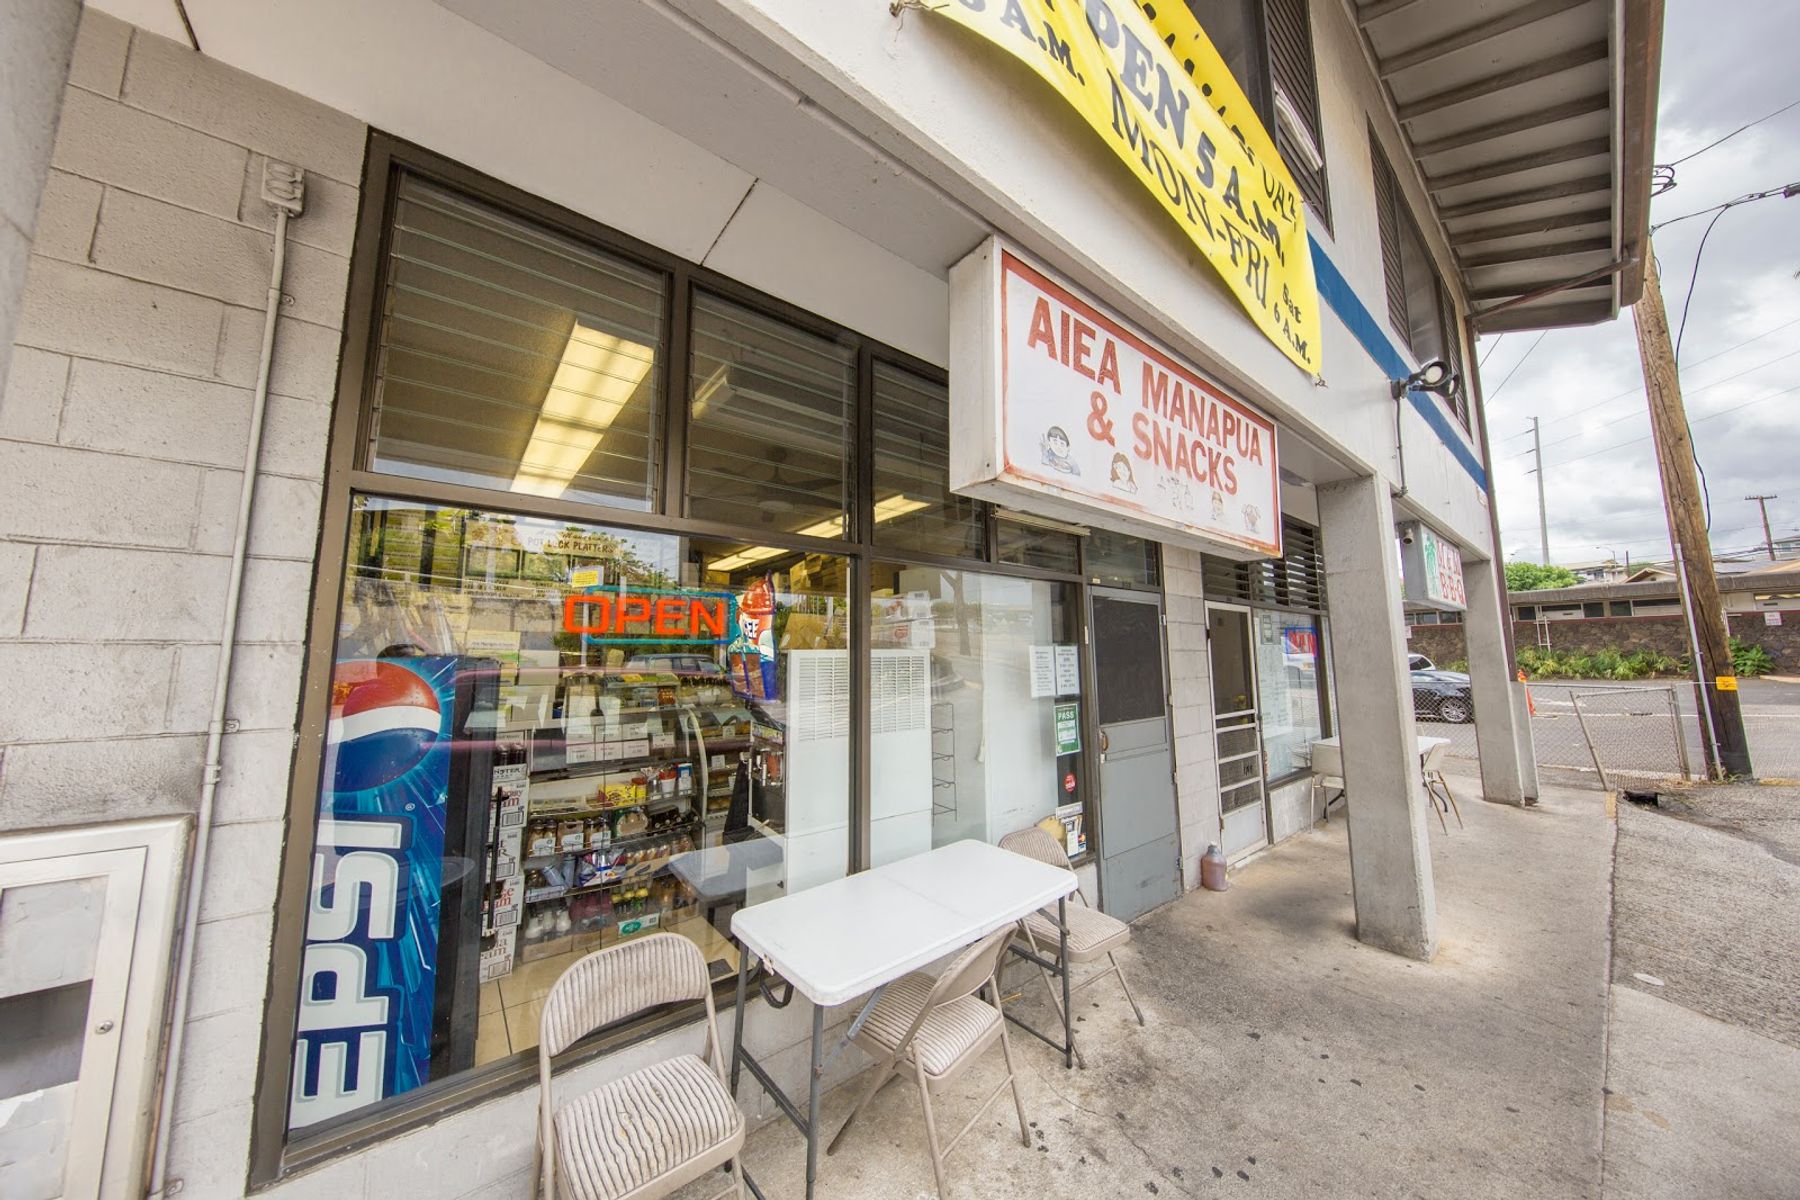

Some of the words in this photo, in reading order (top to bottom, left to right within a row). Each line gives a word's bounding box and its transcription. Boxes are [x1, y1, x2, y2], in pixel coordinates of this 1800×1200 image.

[1106, 67, 1269, 310] MON-FRI
[1222, 165, 1285, 268] A.M.
[1027, 295, 1122, 395] AIEA
[1141, 359, 1263, 466] MANAPUA
[1086, 390, 1116, 448] &
[1131, 411, 1238, 496] SNACKS
[563, 594, 726, 636] OPEN
[1057, 710, 1075, 721] PASS
